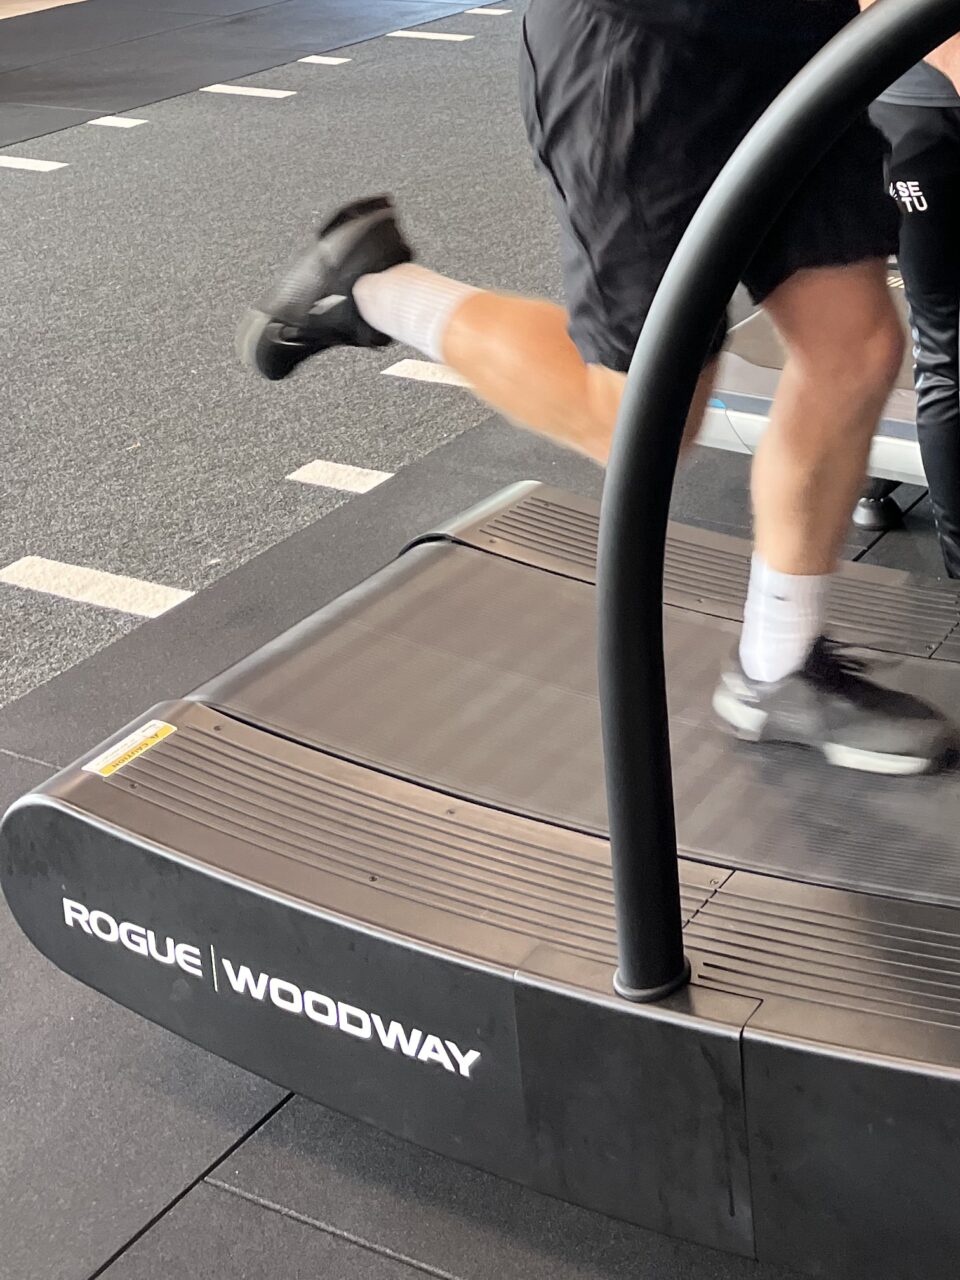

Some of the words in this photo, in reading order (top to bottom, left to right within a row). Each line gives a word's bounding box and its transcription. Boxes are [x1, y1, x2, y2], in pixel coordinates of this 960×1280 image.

[895, 181, 923, 197] SE
[900, 195, 928, 213] TU
[62, 897, 203, 977] ROGUE
[221, 957, 481, 1078] WOODWAY
